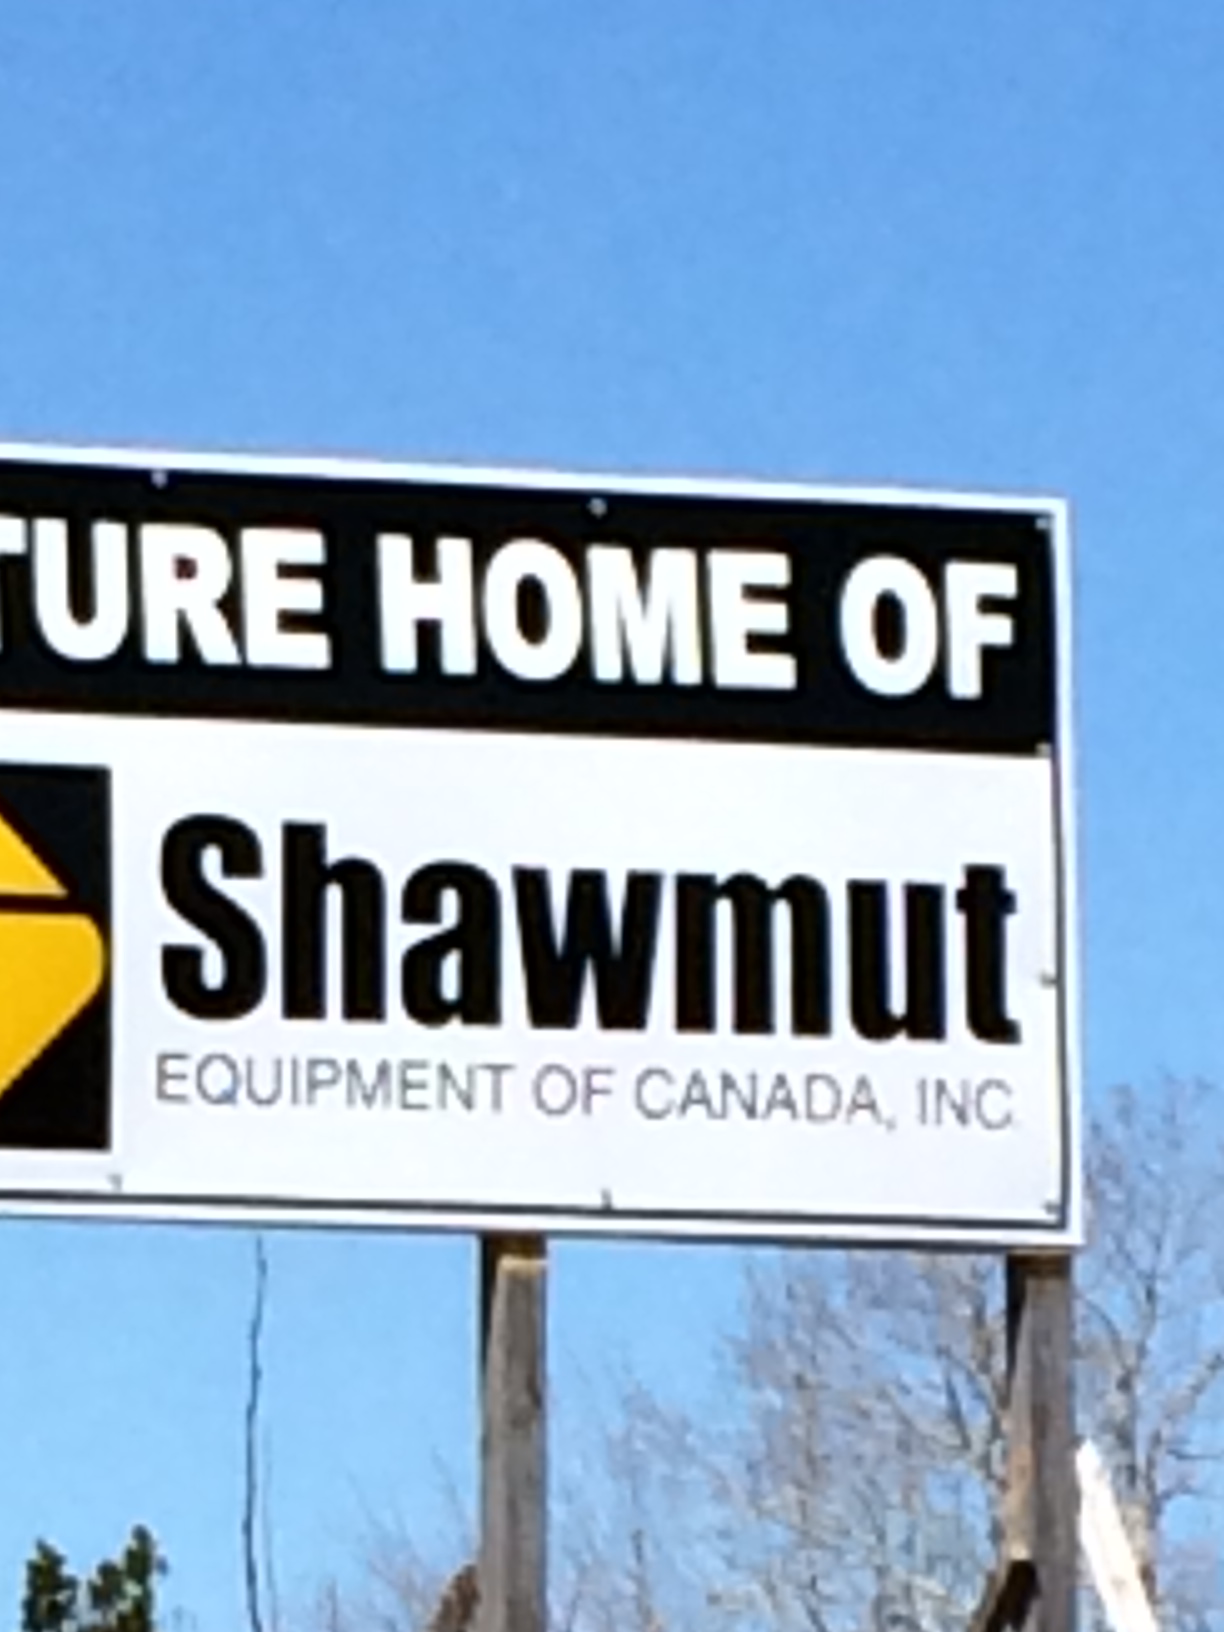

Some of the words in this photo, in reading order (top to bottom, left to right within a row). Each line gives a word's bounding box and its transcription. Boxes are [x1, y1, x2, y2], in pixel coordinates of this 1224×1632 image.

[376, 533, 797, 690] HOME
[838, 553, 1019, 700] OF
[159, 813, 1022, 1045] Shawmut
[155, 1053, 514, 1118] EQUIPMENT
[532, 1062, 616, 1118] OF
[633, 1066, 898, 1132] CANADA,
